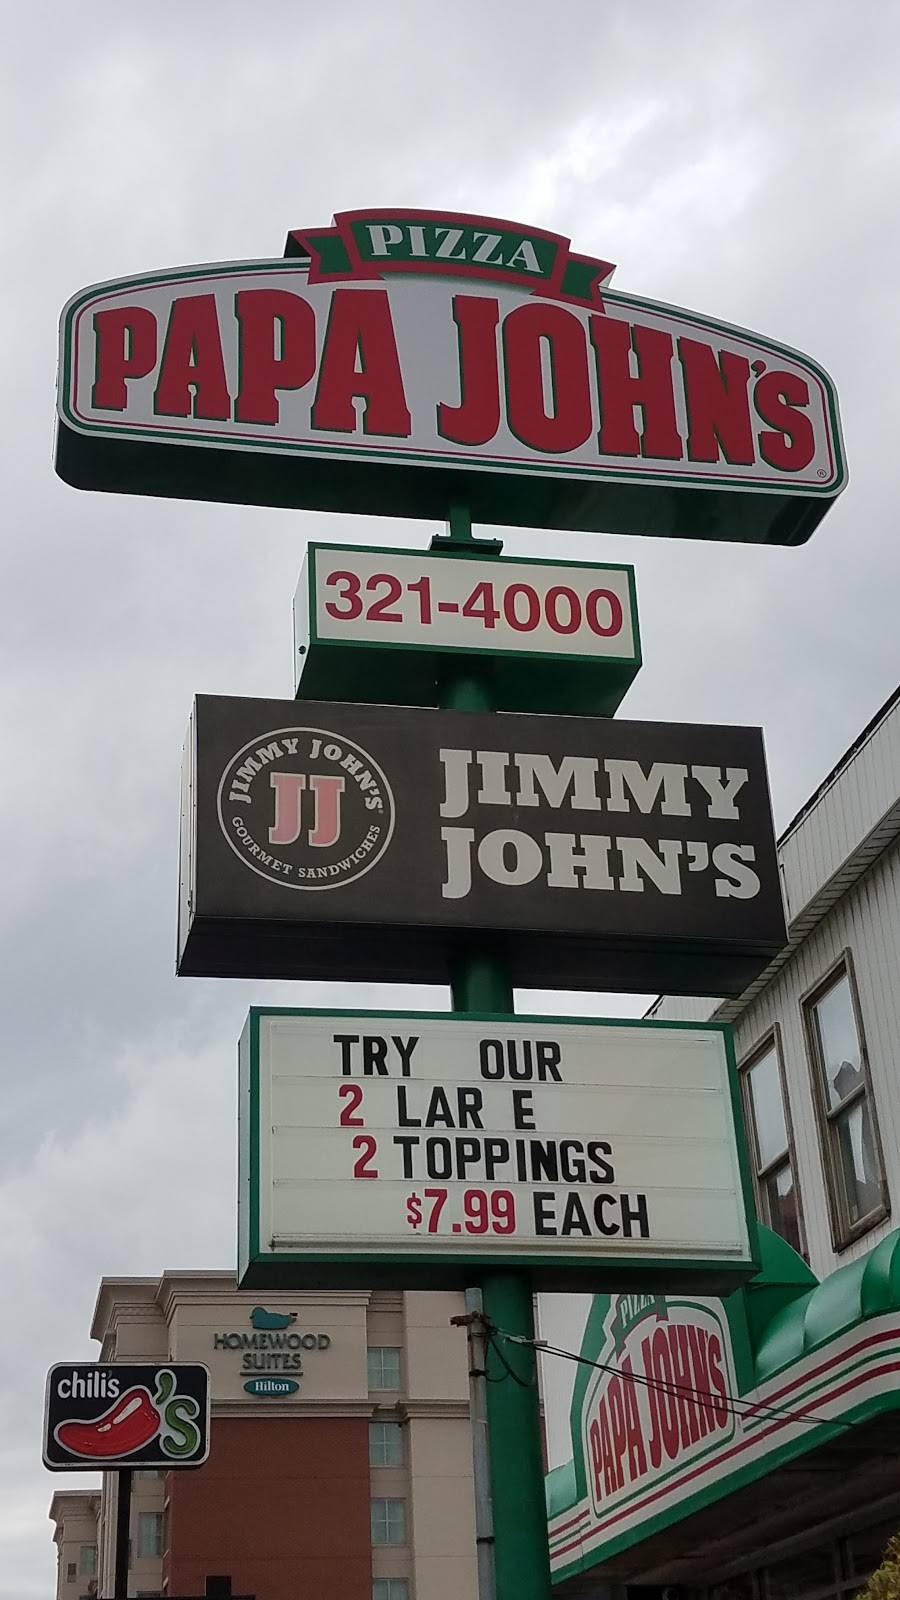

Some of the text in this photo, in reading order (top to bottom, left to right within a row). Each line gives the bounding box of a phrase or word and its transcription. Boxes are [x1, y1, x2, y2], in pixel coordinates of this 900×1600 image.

[368, 223, 546, 275] PIZZA
[92, 289, 816, 472] PAPA JOHN'S
[324, 570, 625, 638] 321-4000
[229, 738, 383, 810] JIMMY JOHN'S
[439, 748, 749, 819] JIMMY
[268, 772, 346, 848] JJ
[232, 816, 381, 879] GOURMET SANDWICHES
[441, 826, 761, 900] JOHN'S
[333, 1034, 562, 1083] TRY OUR
[339, 1084, 364, 1127] 2
[397, 1086, 483, 1129] LAR
[352, 1135, 616, 1184] 2 TOPPINGS
[406, 1189, 650, 1238] $7.99 EACH
[214, 1333, 331, 1350] HOMEWOOD
[242, 1353, 302, 1370] SUITES
[57, 1370, 120, 1398] chili's
[255, 1381, 290, 1391] Hilton
[590, 1356, 647, 1502] PAPA
